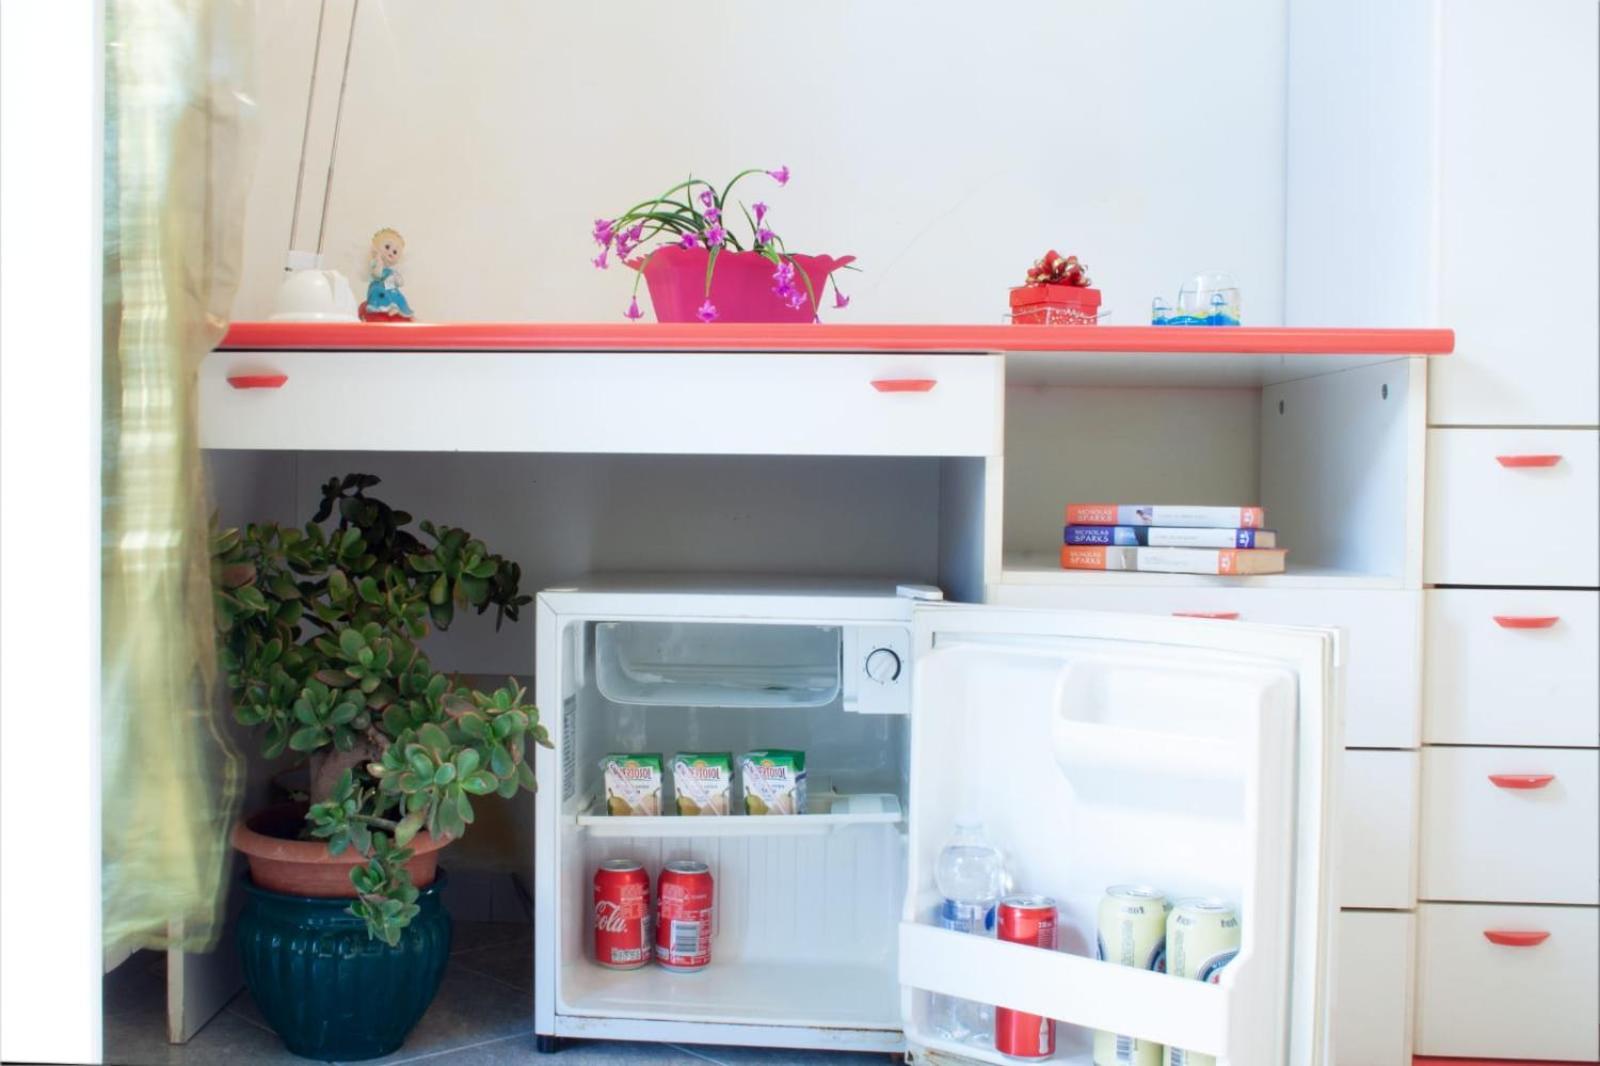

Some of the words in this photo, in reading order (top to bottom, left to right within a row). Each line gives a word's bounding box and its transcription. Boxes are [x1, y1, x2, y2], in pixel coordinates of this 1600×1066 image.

[1077, 514, 1112, 522] SPARKS
[1073, 535, 1109, 543] SPARKS
[1070, 557, 1101, 565] SPARKS
